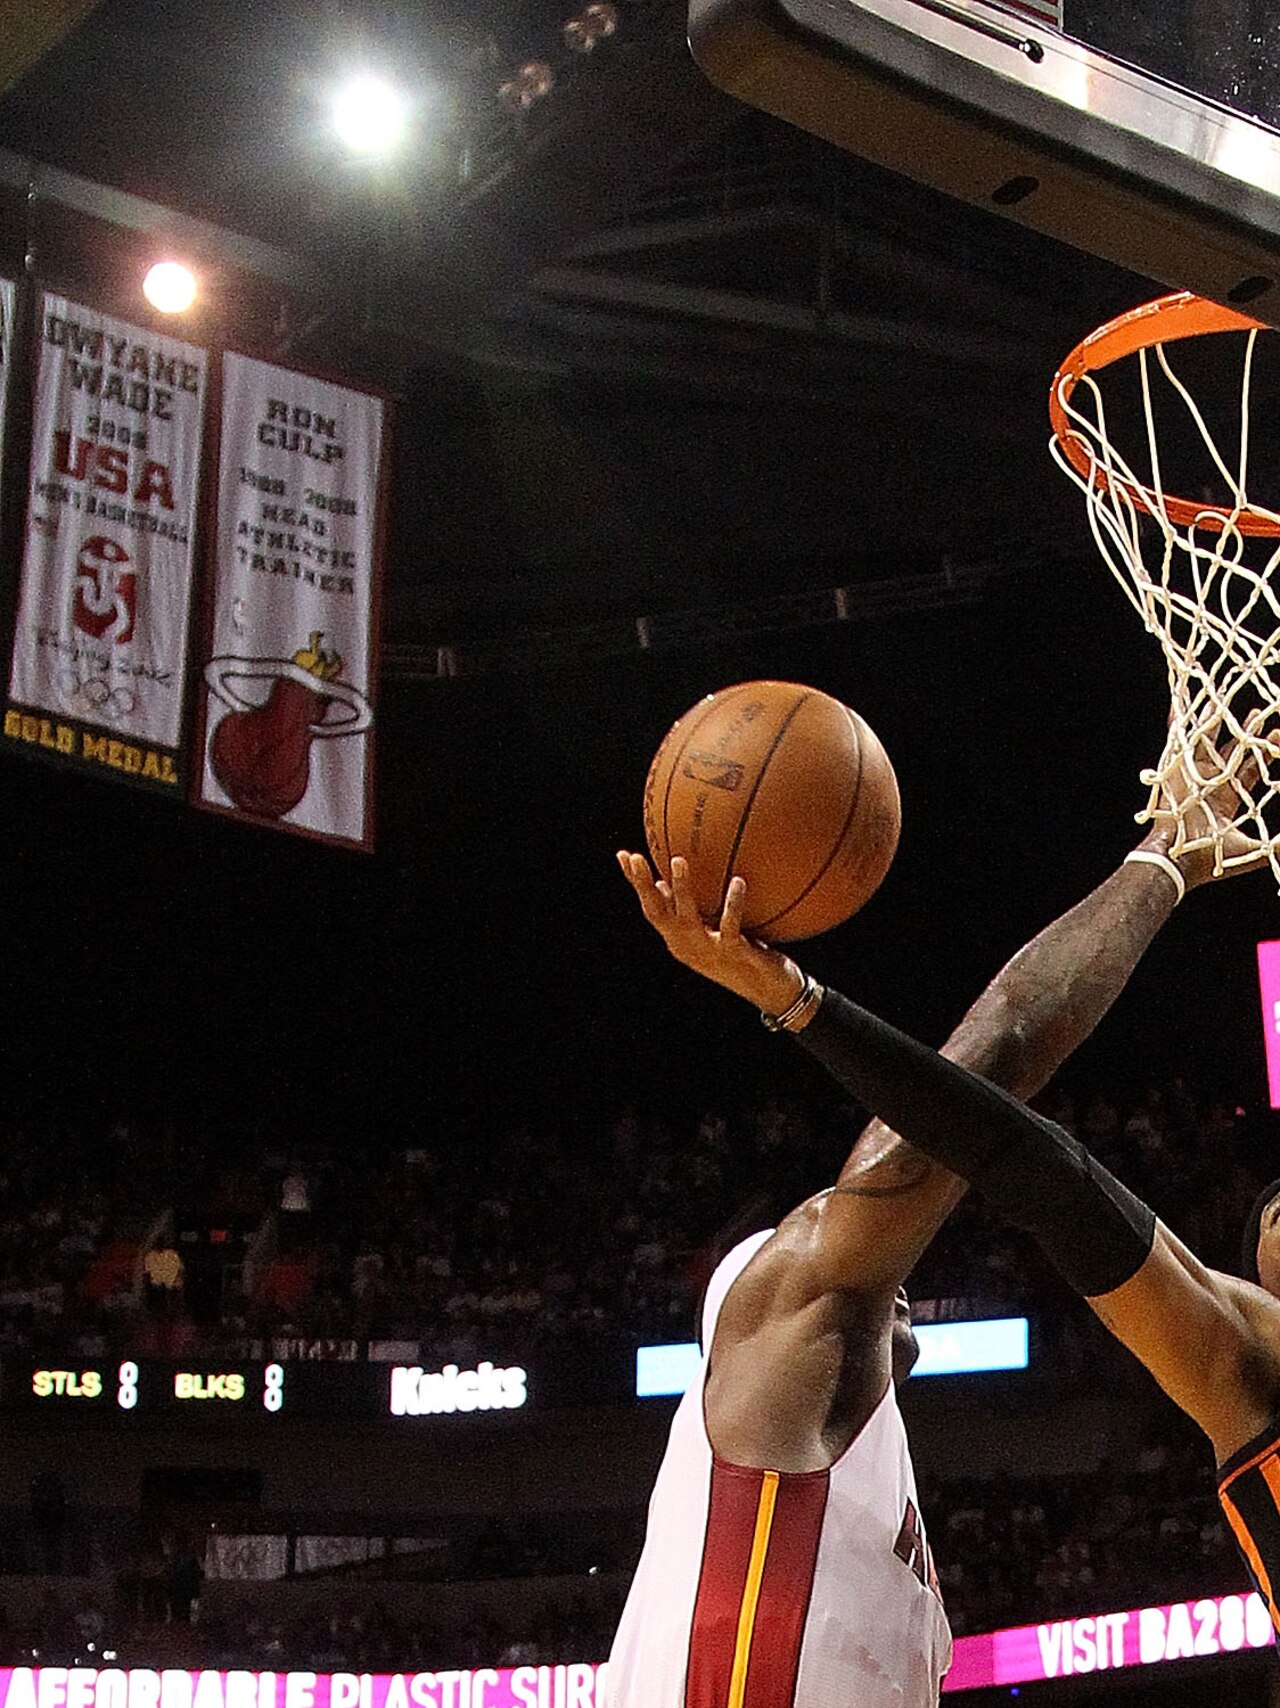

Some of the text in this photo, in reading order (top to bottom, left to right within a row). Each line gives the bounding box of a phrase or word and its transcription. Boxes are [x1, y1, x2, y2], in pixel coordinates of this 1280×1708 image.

[68, 358, 173, 421] WADE
[256, 421, 345, 464] CULP
[266, 399, 336, 439] RON
[54, 431, 175, 511] USA
[236, 520, 355, 569] ATHLETIC
[262, 503, 326, 538] HEAD
[236, 546, 354, 596] TRAINER
[4, 710, 179, 784] GOLD MEDAL
[33, 1370, 102, 1398] STLS
[175, 1373, 245, 1400] BLKS
[390, 1361, 527, 1416] Knicks
[1037, 1612, 1129, 1678] VISIT
